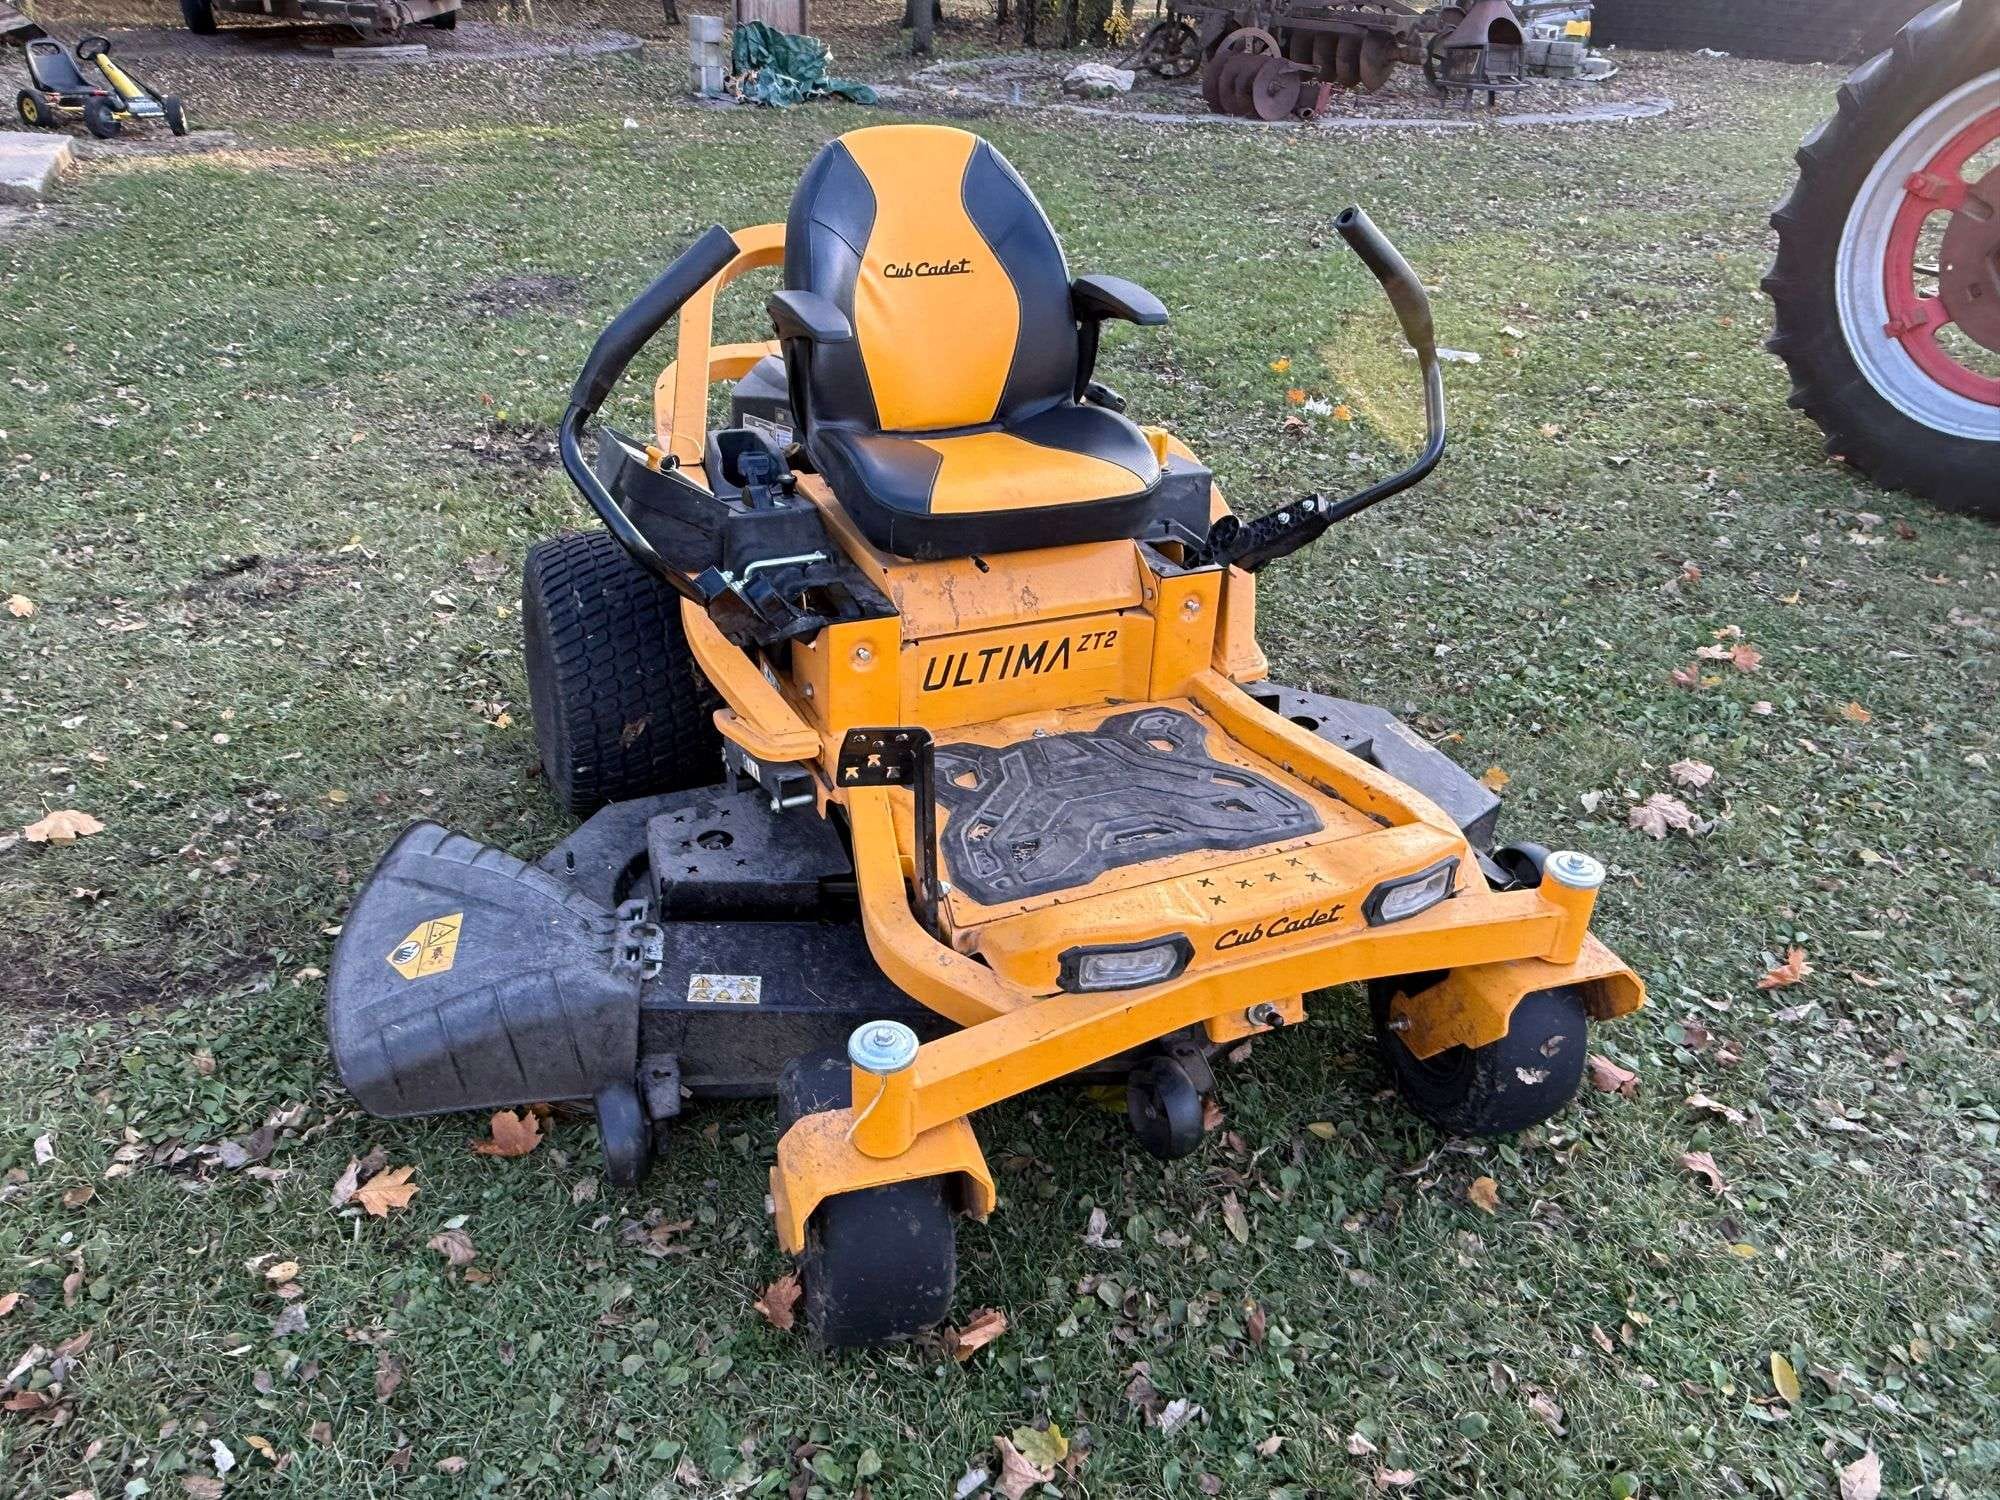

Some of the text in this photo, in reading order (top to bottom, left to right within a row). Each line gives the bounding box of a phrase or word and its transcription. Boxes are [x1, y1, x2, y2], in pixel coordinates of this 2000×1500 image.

[884, 258, 971, 278] Cub Cadet
[923, 630, 1118, 691] ULTIMA ZT2
[1215, 904, 1345, 950] Cub Cadet
